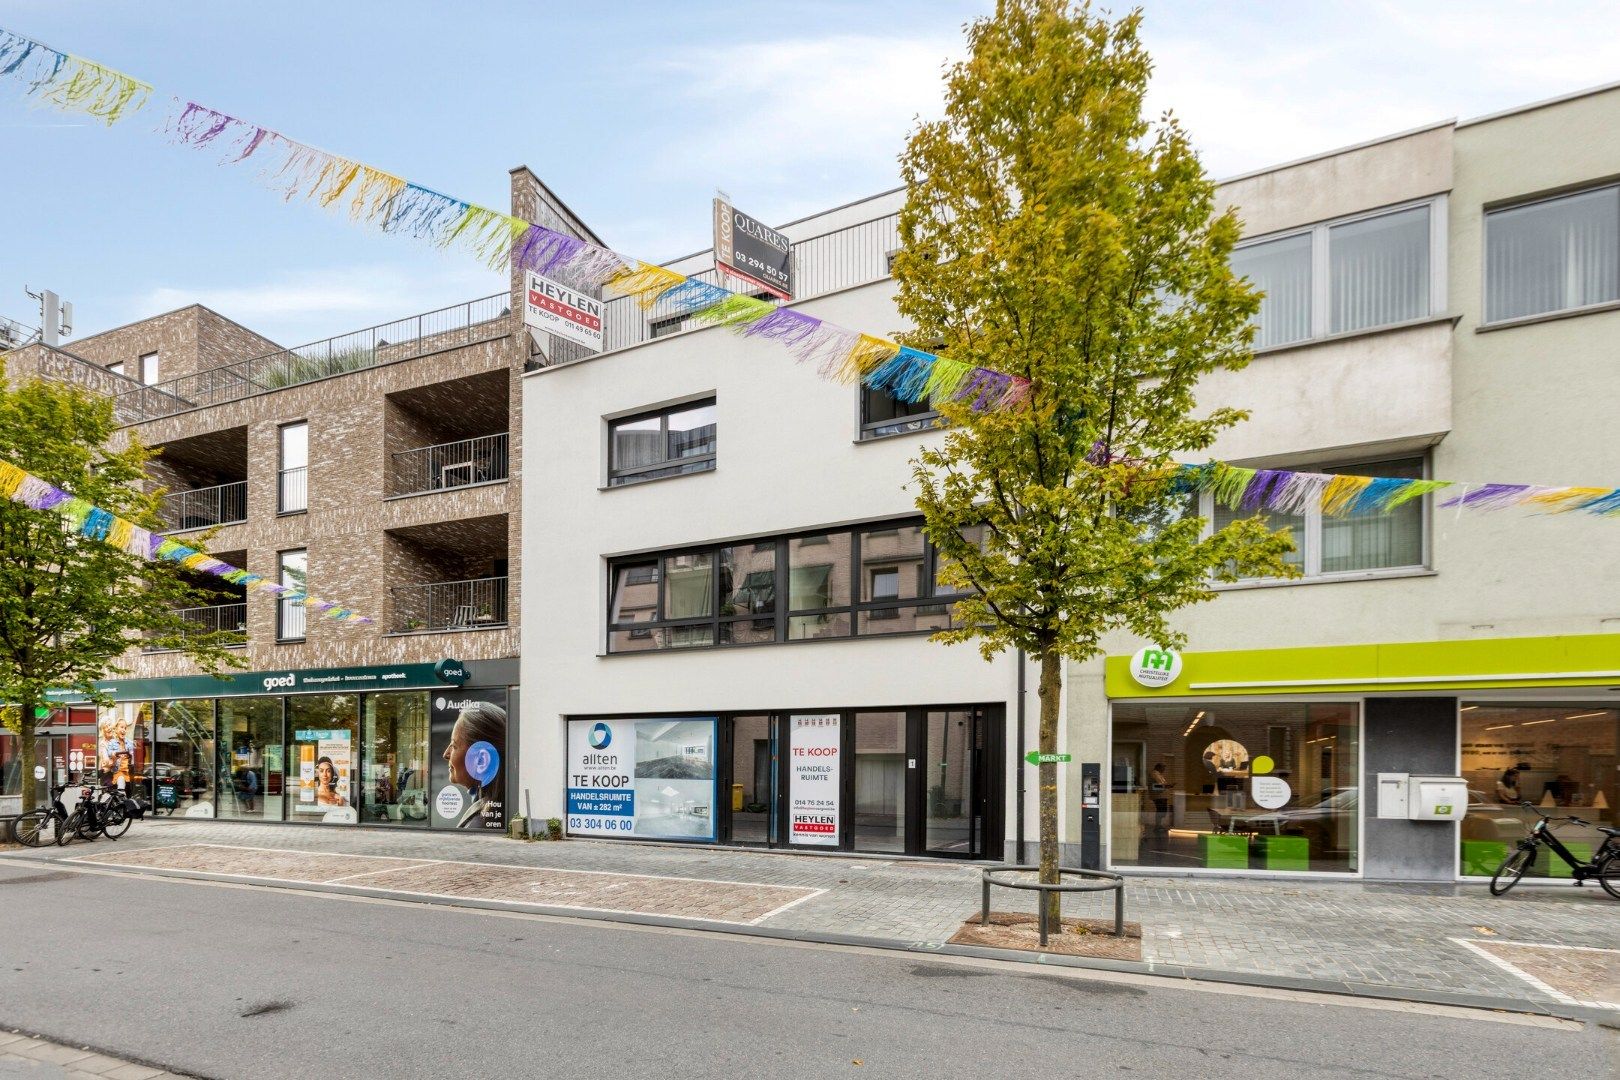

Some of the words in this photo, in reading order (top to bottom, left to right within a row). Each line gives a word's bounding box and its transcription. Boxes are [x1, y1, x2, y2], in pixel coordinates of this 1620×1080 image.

[722, 204, 731, 244] KOOP
[734, 213, 788, 252] QUARES
[722, 246, 731, 259] TE
[736, 251, 746, 262] 03
[748, 258, 764, 270] 294
[766, 266, 776, 276] 50
[779, 271, 788, 282] 57
[532, 278, 598, 316] HEYLEN
[532, 294, 598, 326] VASTGOED
[529, 305, 537, 314] TE
[539, 310, 559, 322] KOOP
[565, 321, 575, 330] 011
[444, 667, 462, 677] goed
[263, 673, 295, 691] goed
[447, 700, 480, 710] Audika
[793, 748, 804, 756] TE
[808, 748, 837, 756] KOOP
[583, 754, 618, 765] allten
[573, 775, 588, 786] TE
[592, 775, 629, 787] KOOP
[570, 793, 631, 801] HANDELSRUIMTE
[495, 811, 501, 819] je
[570, 818, 581, 828] 03
[585, 819, 601, 828] 304
[605, 820, 617, 830] 06
[620, 820, 632, 830] 00
